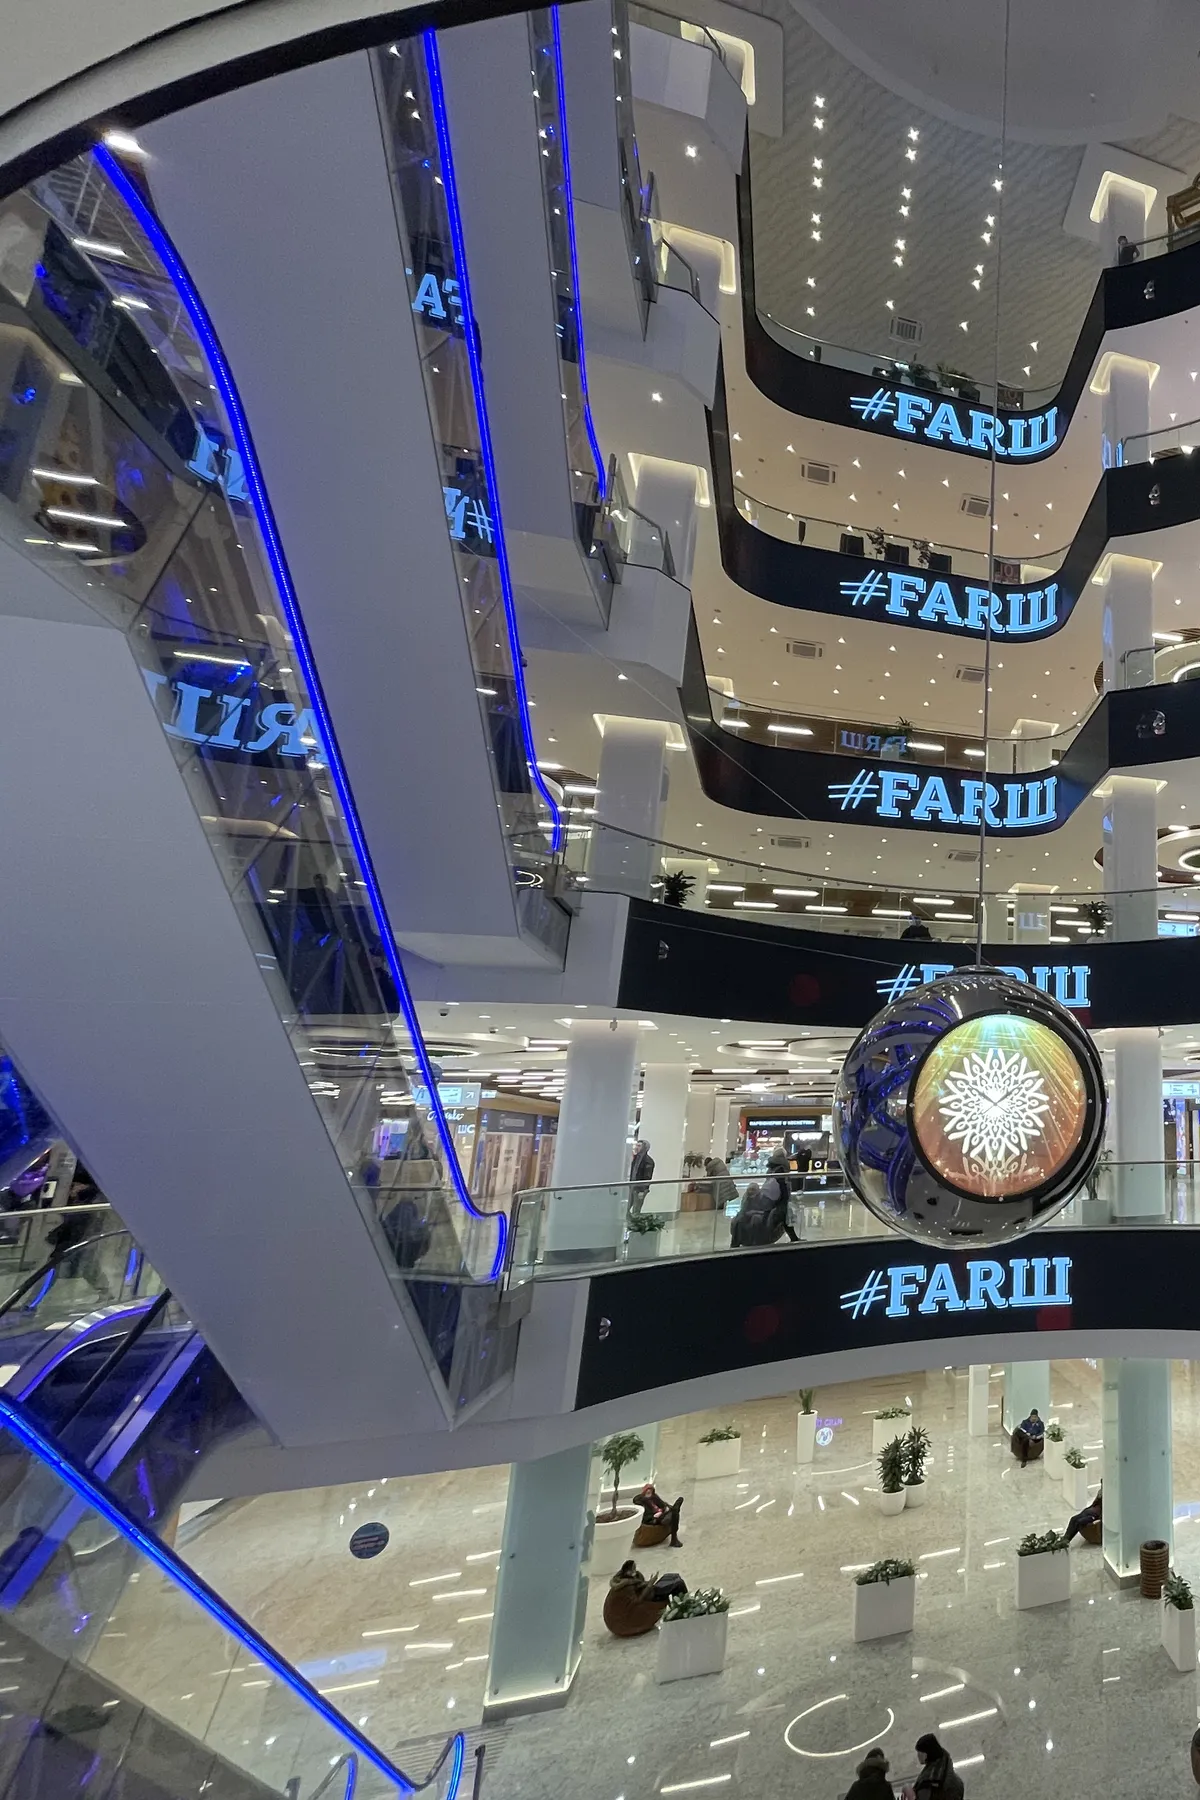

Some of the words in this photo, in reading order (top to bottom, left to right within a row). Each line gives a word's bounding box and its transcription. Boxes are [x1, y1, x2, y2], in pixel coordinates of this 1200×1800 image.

[850, 387, 1058, 457] #FARШ
[840, 569, 1058, 634] #FARШ
[828, 769, 1057, 828] #FARШ
[840, 1256, 1073, 1319] #FARШ
